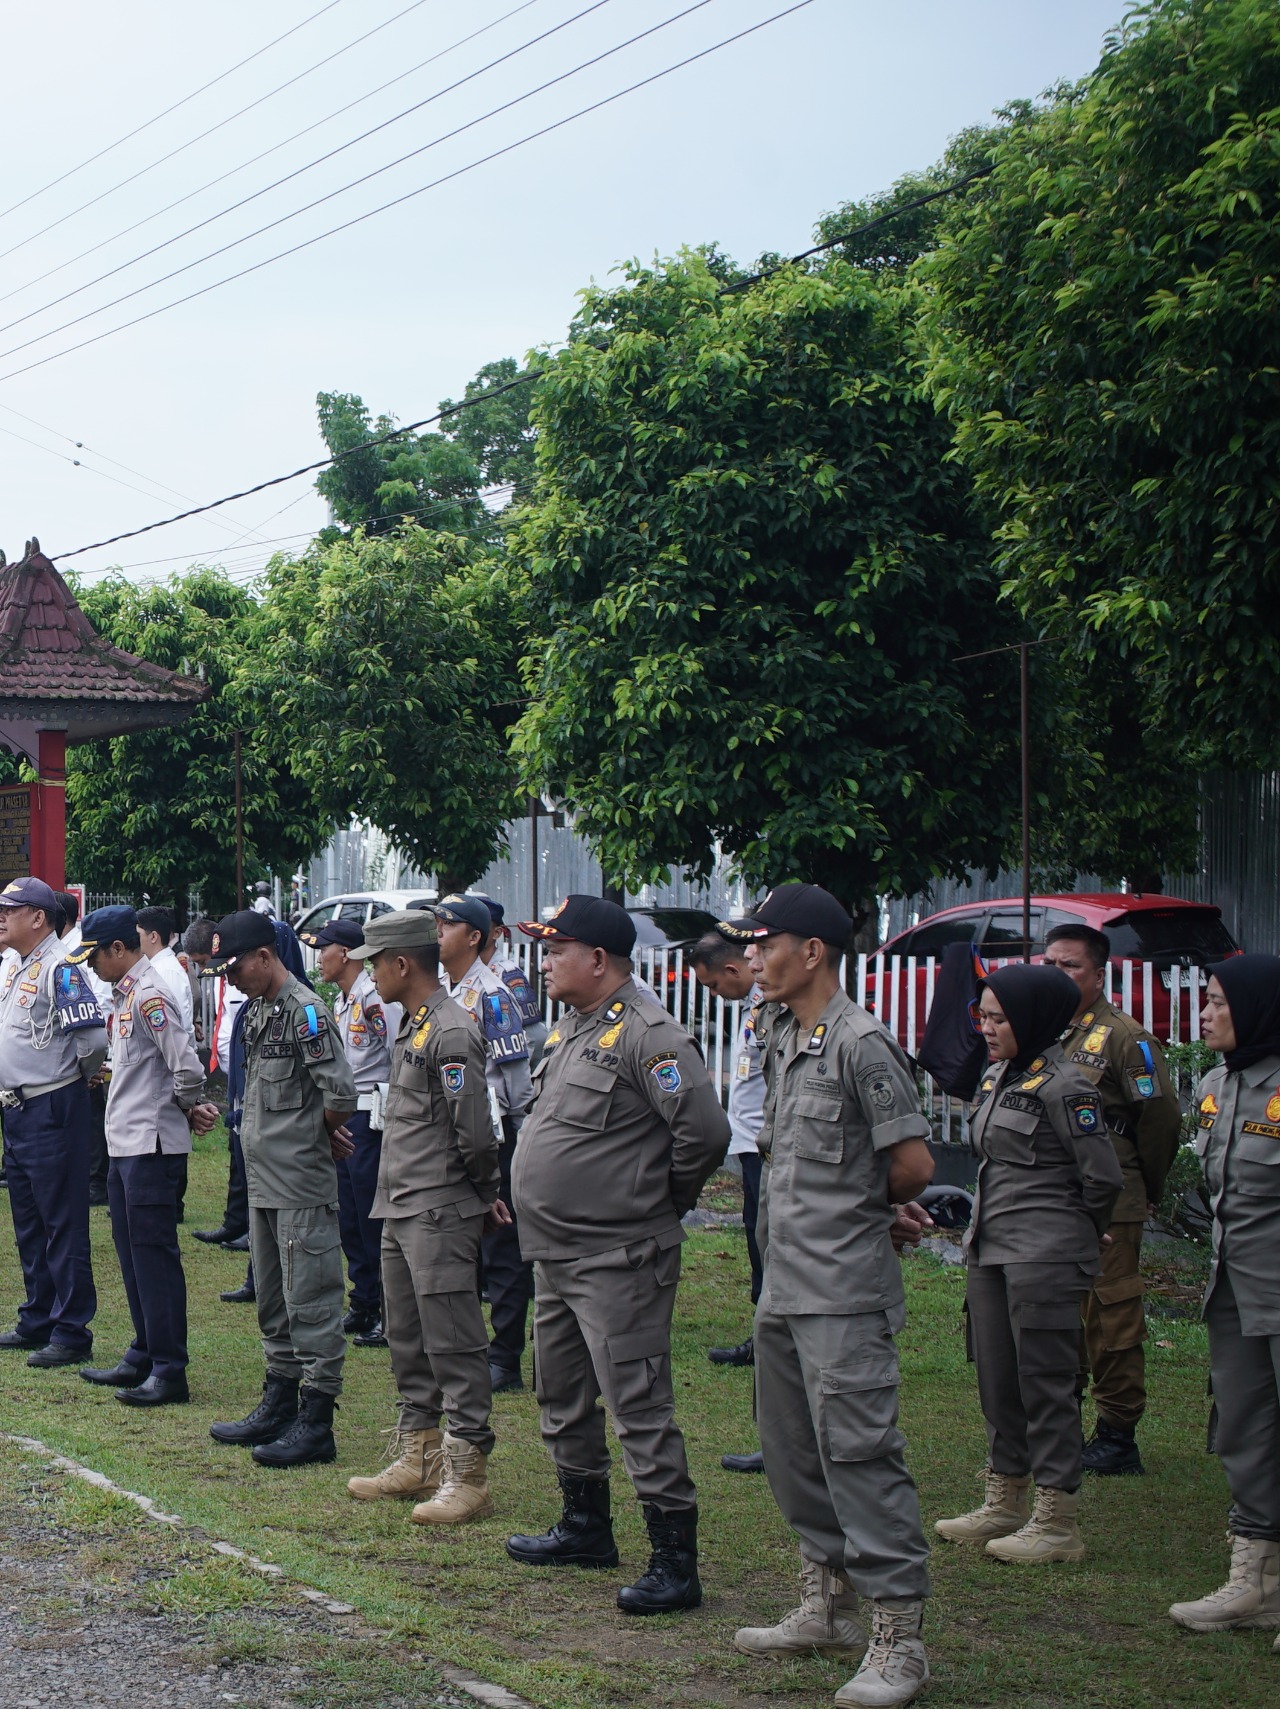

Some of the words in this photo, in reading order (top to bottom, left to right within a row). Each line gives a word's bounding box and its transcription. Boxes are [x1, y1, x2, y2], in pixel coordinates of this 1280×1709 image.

[262, 1046, 278, 1057] POL
[279, 1045, 292, 1056] PP
[580, 1047, 601, 1062] POL
[600, 1053, 620, 1067] PP
[1003, 1094, 1023, 1111] POL
[1024, 1101, 1042, 1115] PP
